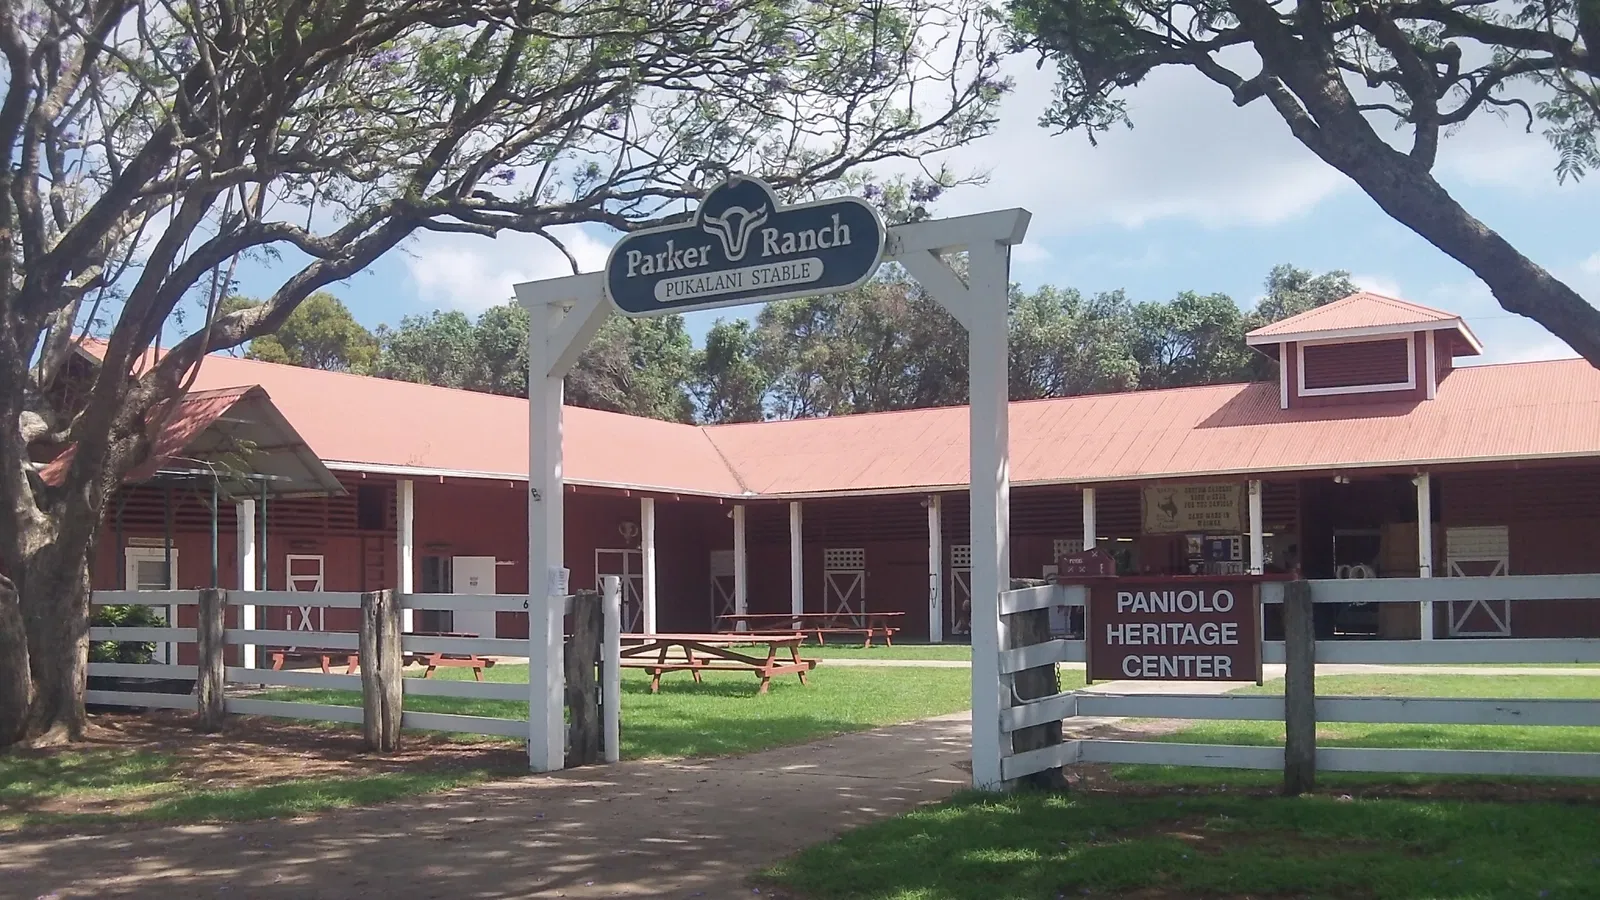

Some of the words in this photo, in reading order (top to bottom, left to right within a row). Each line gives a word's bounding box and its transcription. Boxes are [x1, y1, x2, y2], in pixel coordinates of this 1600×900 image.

[626, 240, 711, 278] Parker
[761, 213, 851, 257] Ranch
[665, 272, 742, 298] PUKALANI
[751, 262, 811, 286] STABLE
[1117, 590, 1233, 613] PANIOLO
[1107, 622, 1239, 645] HERITAGE
[1122, 655, 1232, 678] CENTER
